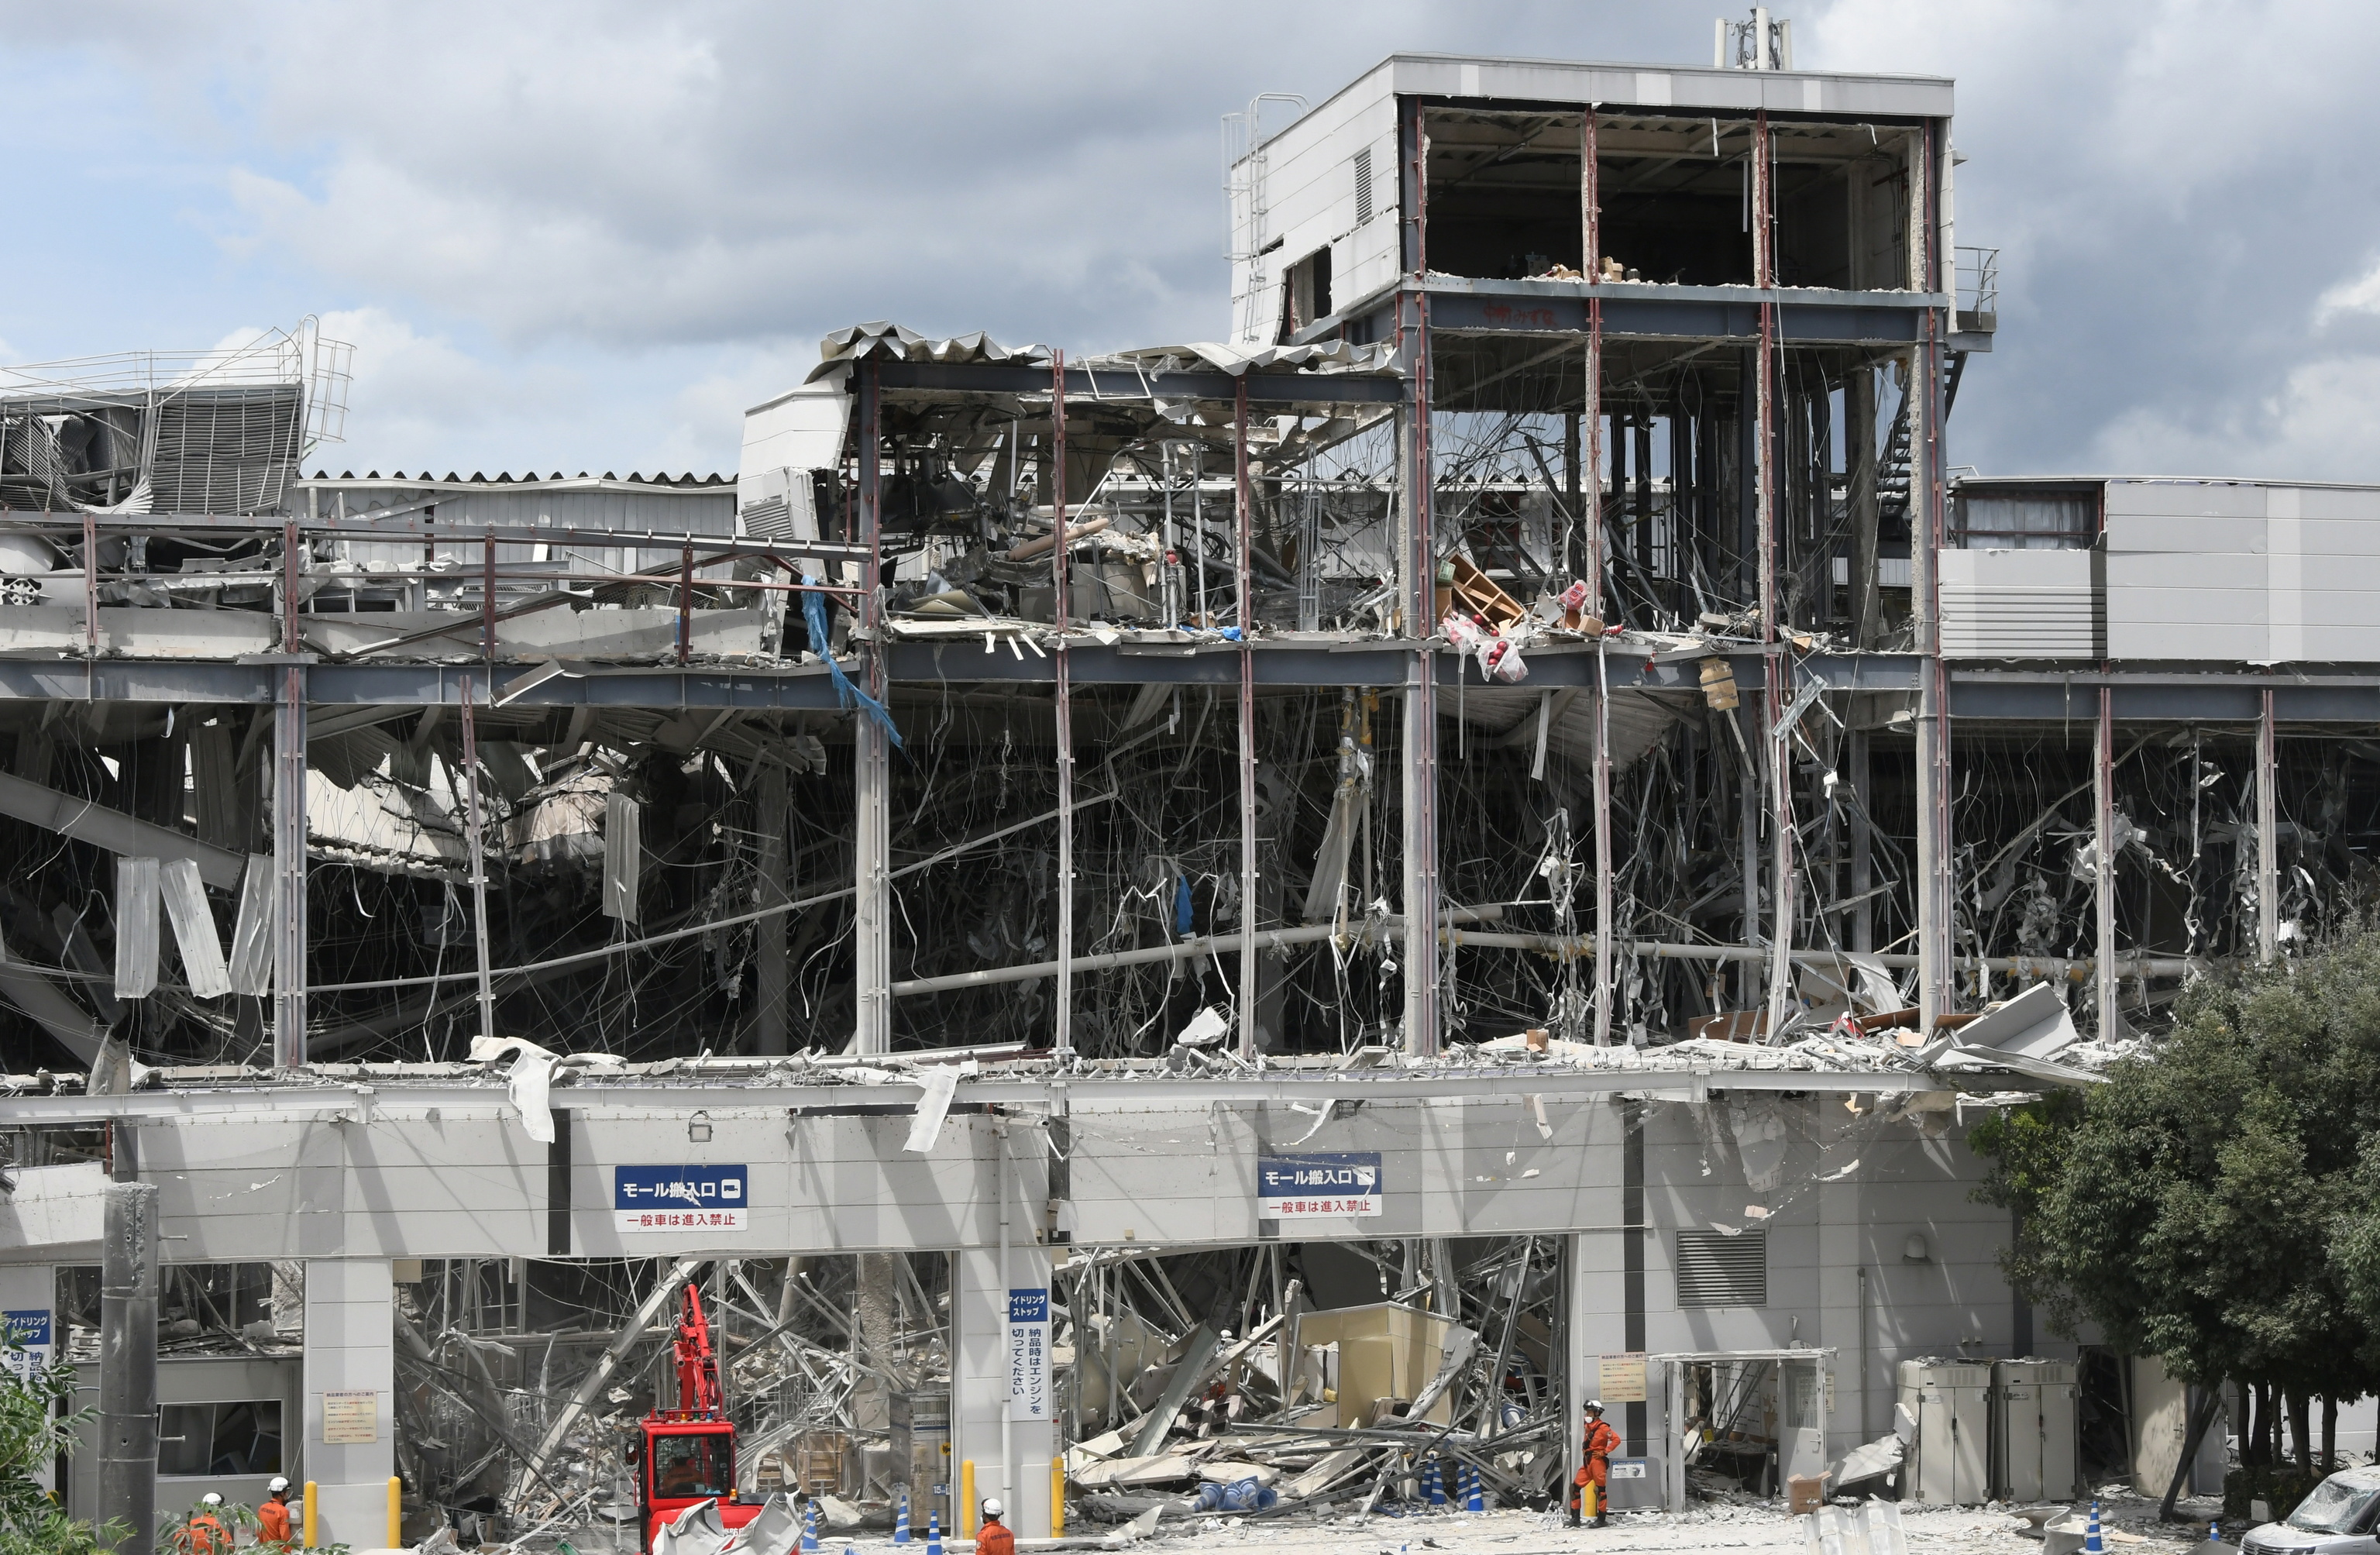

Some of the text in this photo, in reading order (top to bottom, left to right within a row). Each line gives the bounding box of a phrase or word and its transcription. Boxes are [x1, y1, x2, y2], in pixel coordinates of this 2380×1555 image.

[1265, 1169, 1352, 1185] モール搬入口
[1269, 1199, 1371, 1213] 一般車は進入禁止
[627, 1213, 735, 1226] 一般車は進入禁止
[1013, 1307, 1039, 1316] ストップ
[1012, 1329, 1024, 1395] 切ってください
[1028, 1328, 1041, 1414] 納品時はエンジンを
